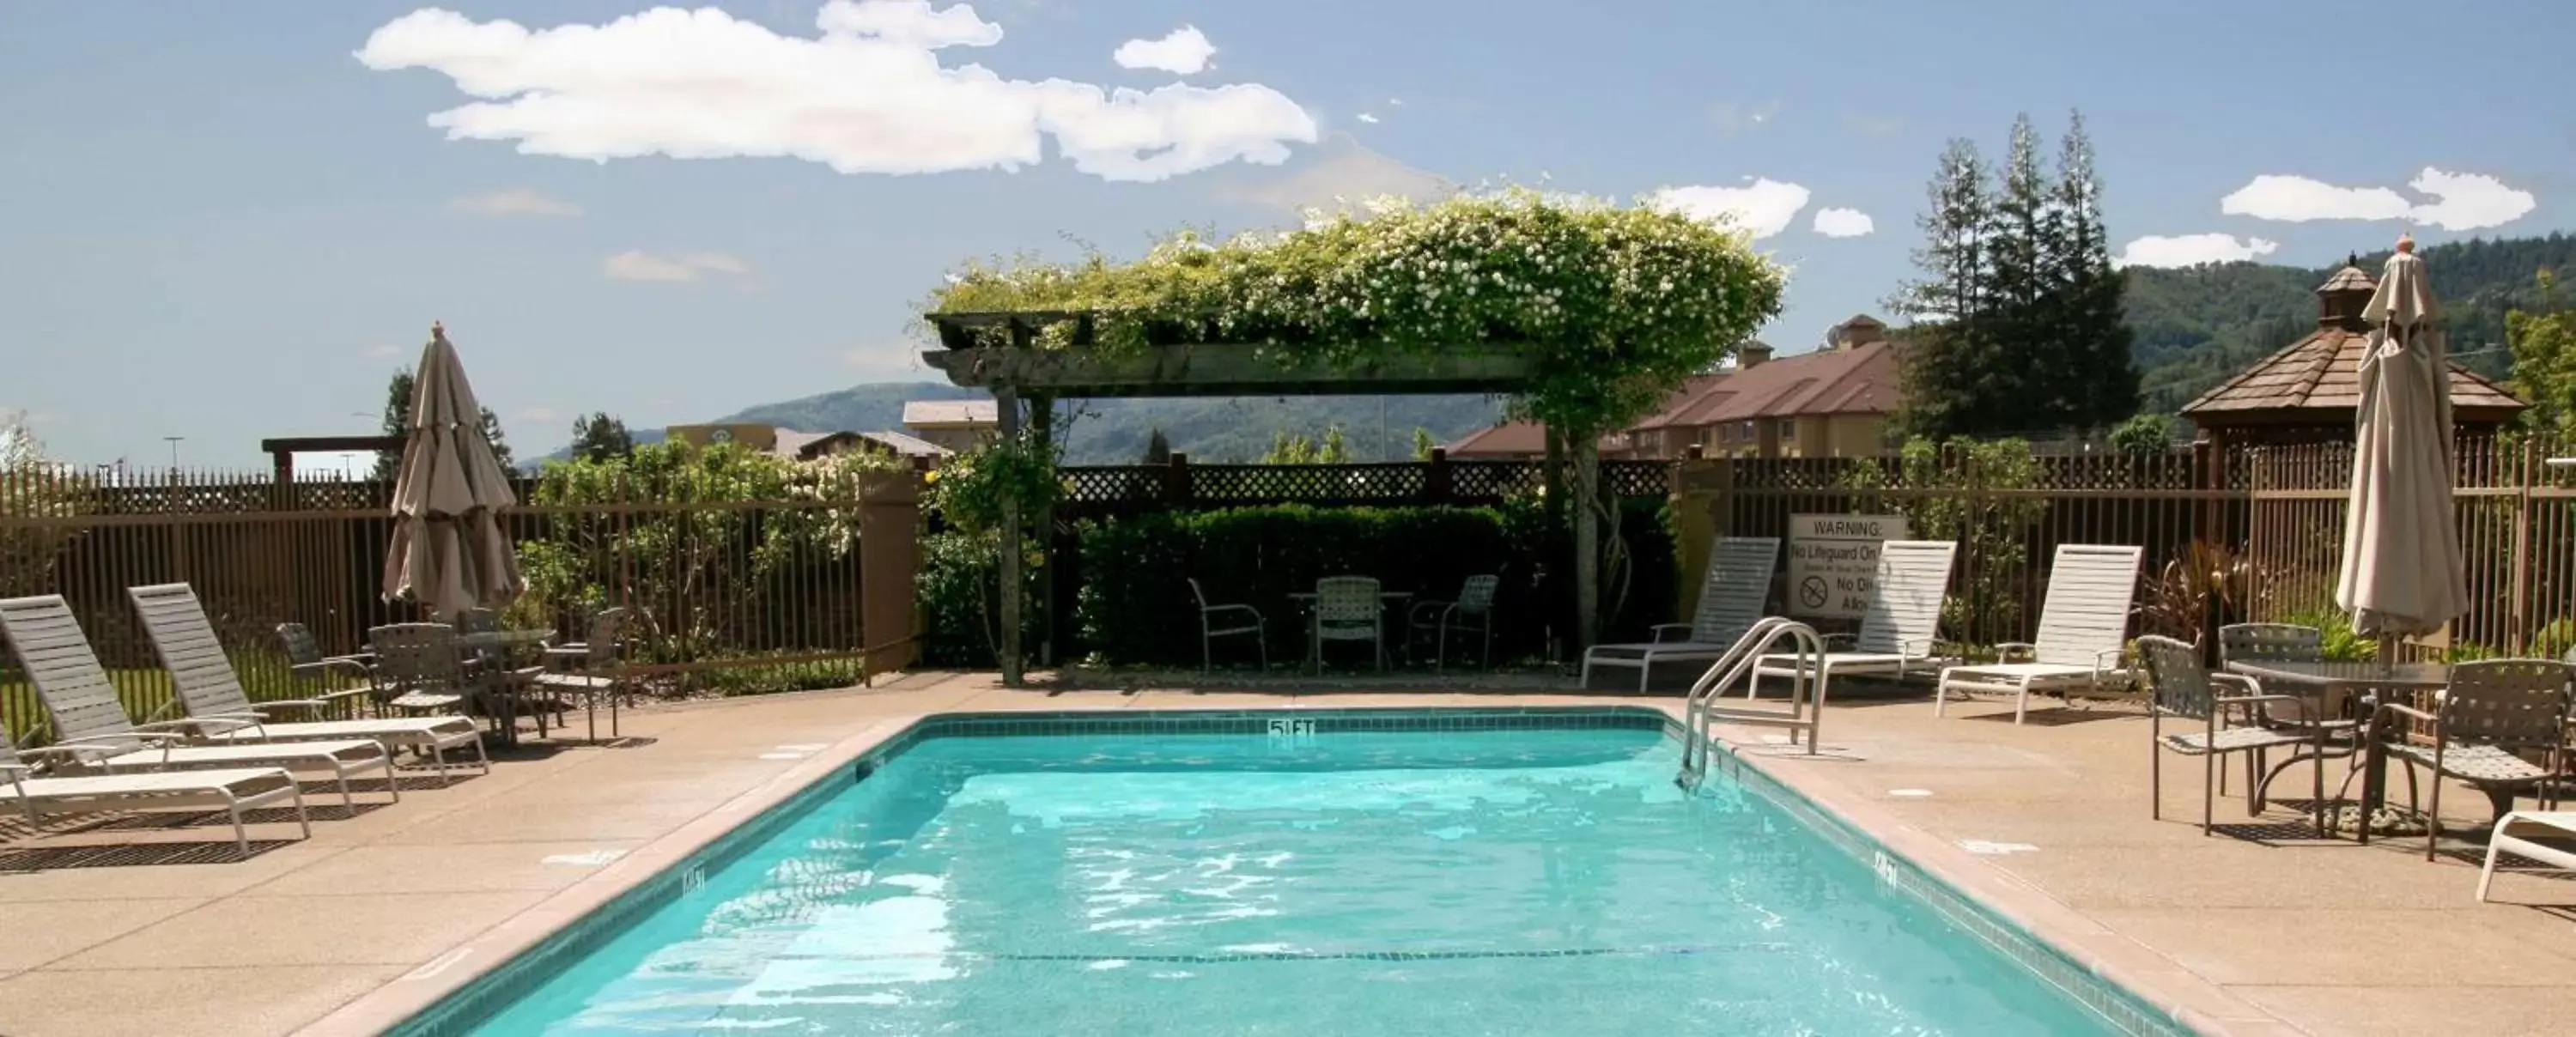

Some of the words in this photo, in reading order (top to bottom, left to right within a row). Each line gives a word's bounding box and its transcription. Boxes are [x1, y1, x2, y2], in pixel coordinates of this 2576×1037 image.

[1814, 521, 1882, 536] WARNING:
[1791, 544, 1805, 559] No
[1807, 544, 1856, 561] Lifeguard
[1859, 545, 1876, 561] On
[1837, 576, 1854, 591] No
